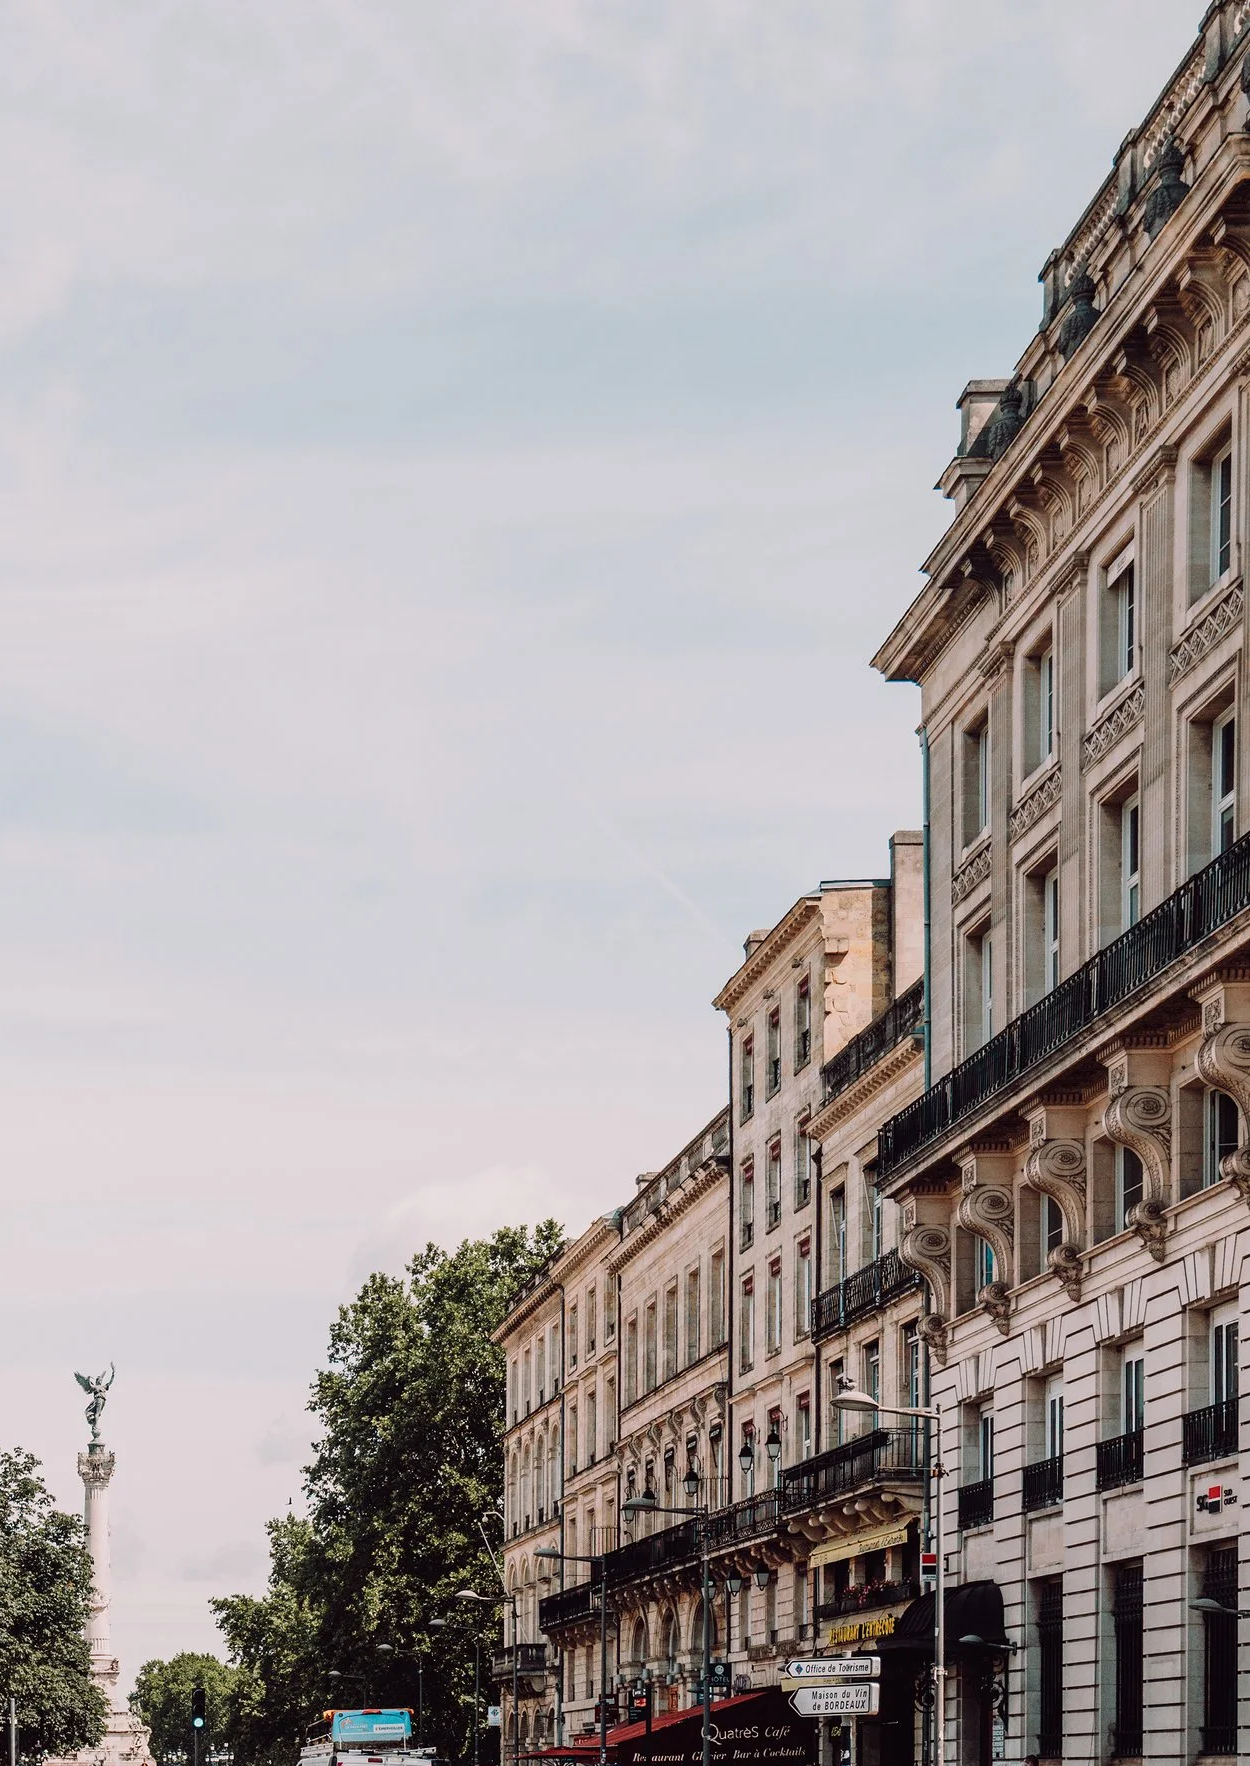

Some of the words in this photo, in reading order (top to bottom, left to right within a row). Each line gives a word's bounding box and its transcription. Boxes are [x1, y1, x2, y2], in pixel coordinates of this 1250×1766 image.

[1224, 1489, 1232, 1497] SUD
[1224, 1495, 1238, 1505] OUEST
[805, 1664, 825, 1673] Office
[827, 1664, 836, 1672] de
[839, 1663, 869, 1672] Tourisme
[811, 1691, 838, 1700] Maison
[842, 1690, 851, 1698] du
[855, 1689, 868, 1698] Vin
[812, 1702, 821, 1711] de
[824, 1700, 866, 1710] BORDEAUX
[764, 1725, 791, 1740] Café
[632, 1752, 685, 1762] Reaurant
[691, 1751, 727, 1761] Glier
[733, 1749, 752, 1759] Bar
[753, 1748, 760, 1758] à
[763, 1746, 806, 1758] Cocktails
